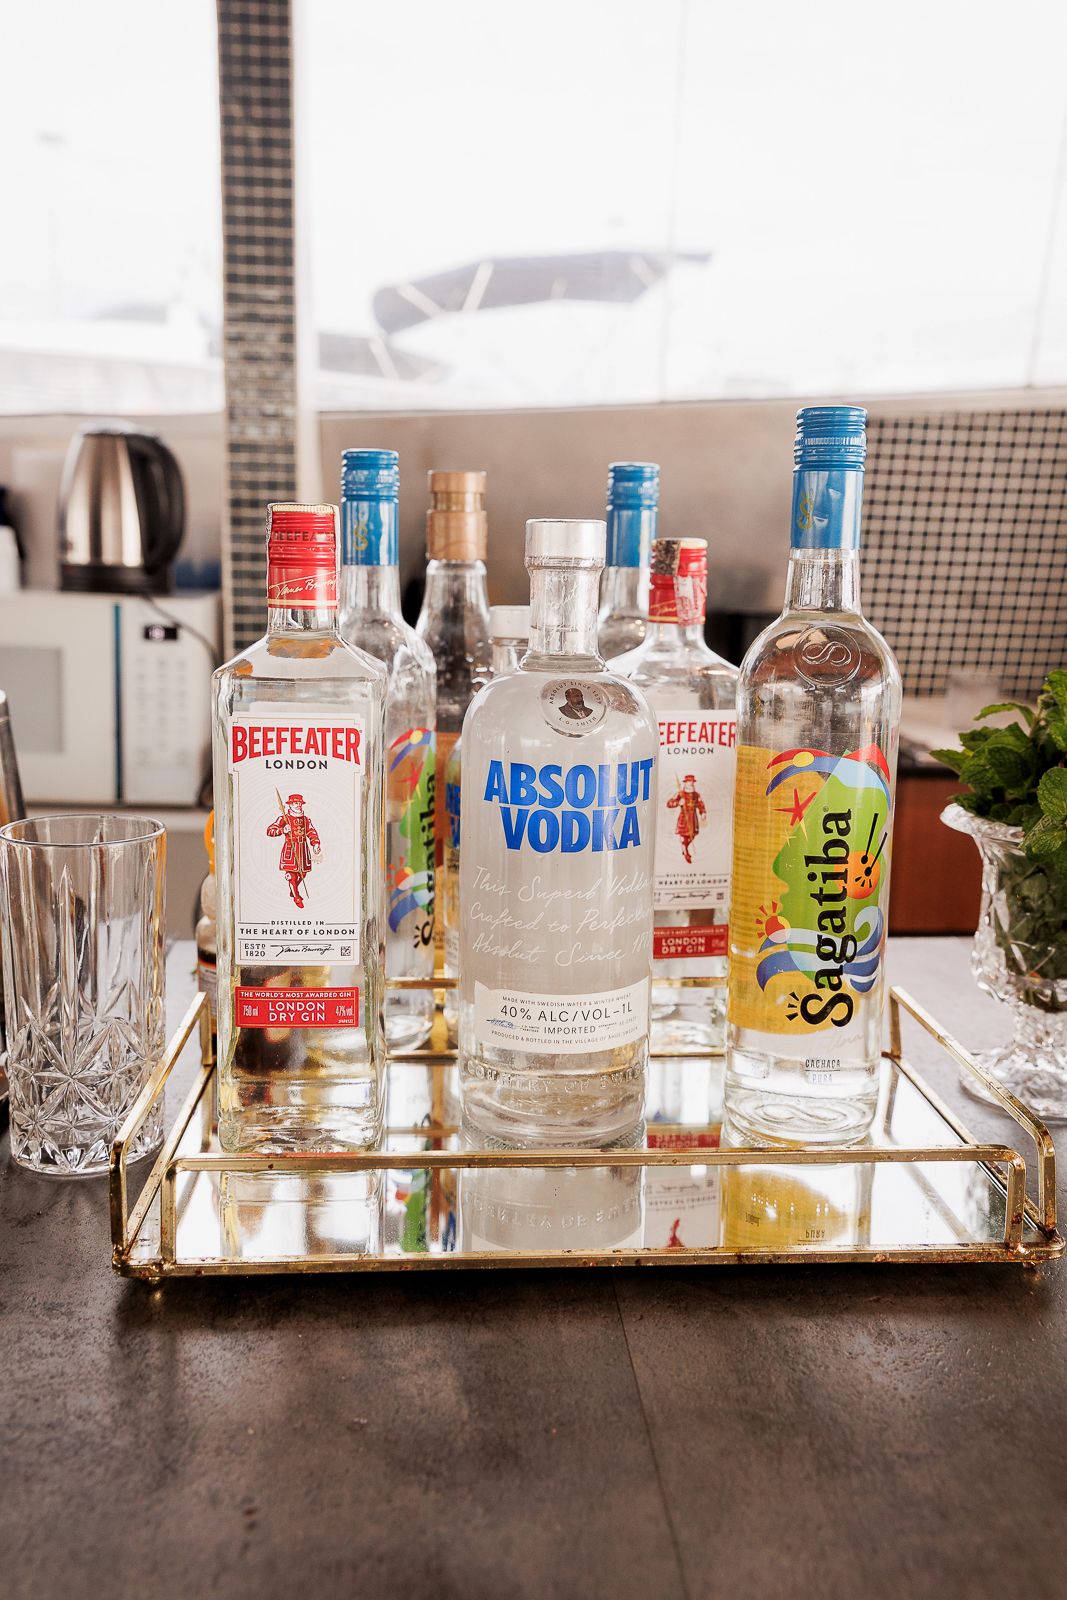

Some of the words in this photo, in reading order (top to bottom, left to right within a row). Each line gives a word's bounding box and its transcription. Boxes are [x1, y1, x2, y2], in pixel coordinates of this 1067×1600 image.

[658, 722, 737, 749] EEFEATER
[232, 725, 361, 766] BEEFEATER
[667, 747, 714, 755] LONDON
[265, 759, 328, 770] LONDON
[483, 757, 654, 809] ABSOLUT
[500, 806, 641, 853] VODKA
[472, 865, 511, 897] This
[518, 875, 603, 908] Superb
[470, 902, 545, 930] Crafted
[548, 919, 570, 933] to
[800, 808, 858, 1028] Sagatiba
[297, 928, 310, 936] OF
[313, 928, 355, 936] LONDON
[661, 936, 706, 946] LONDON
[472, 932, 546, 963] Absolut
[555, 942, 626, 967] Since
[661, 946, 683, 955] DRY
[686, 944, 706, 953] GIN
[269, 1001, 325, 1011] LONDON
[269, 1012, 296, 1022] DRY
[301, 1012, 325, 1022] GIN
[500, 1004, 532, 1021] 40%
[491, 1029, 520, 1041] PRODUCED
[544, 1025, 596, 1035] IMPORTED
[805, 1059, 840, 1069] CACHAÇA
